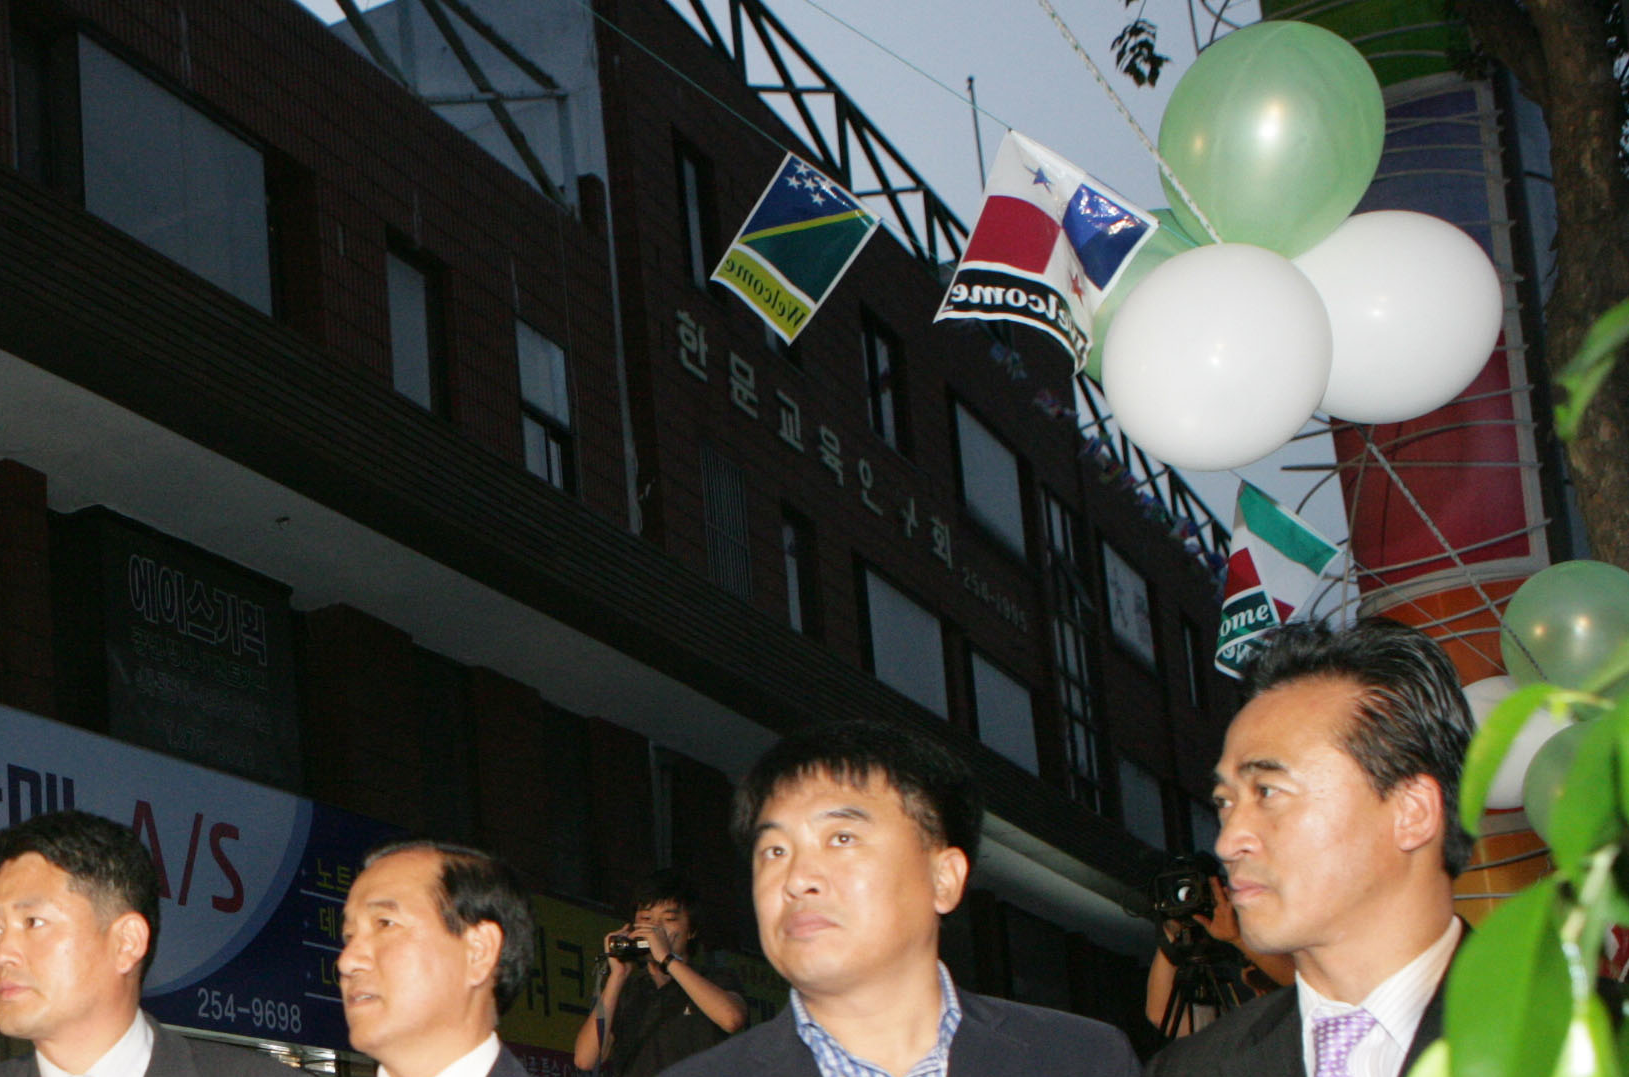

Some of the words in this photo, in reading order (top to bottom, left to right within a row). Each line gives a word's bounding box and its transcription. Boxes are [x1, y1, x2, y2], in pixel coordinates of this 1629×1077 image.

[128, 554, 269, 666] 에이스기획
[132, 800, 245, 913] A/S
[197, 987, 302, 1034] 254-9698
